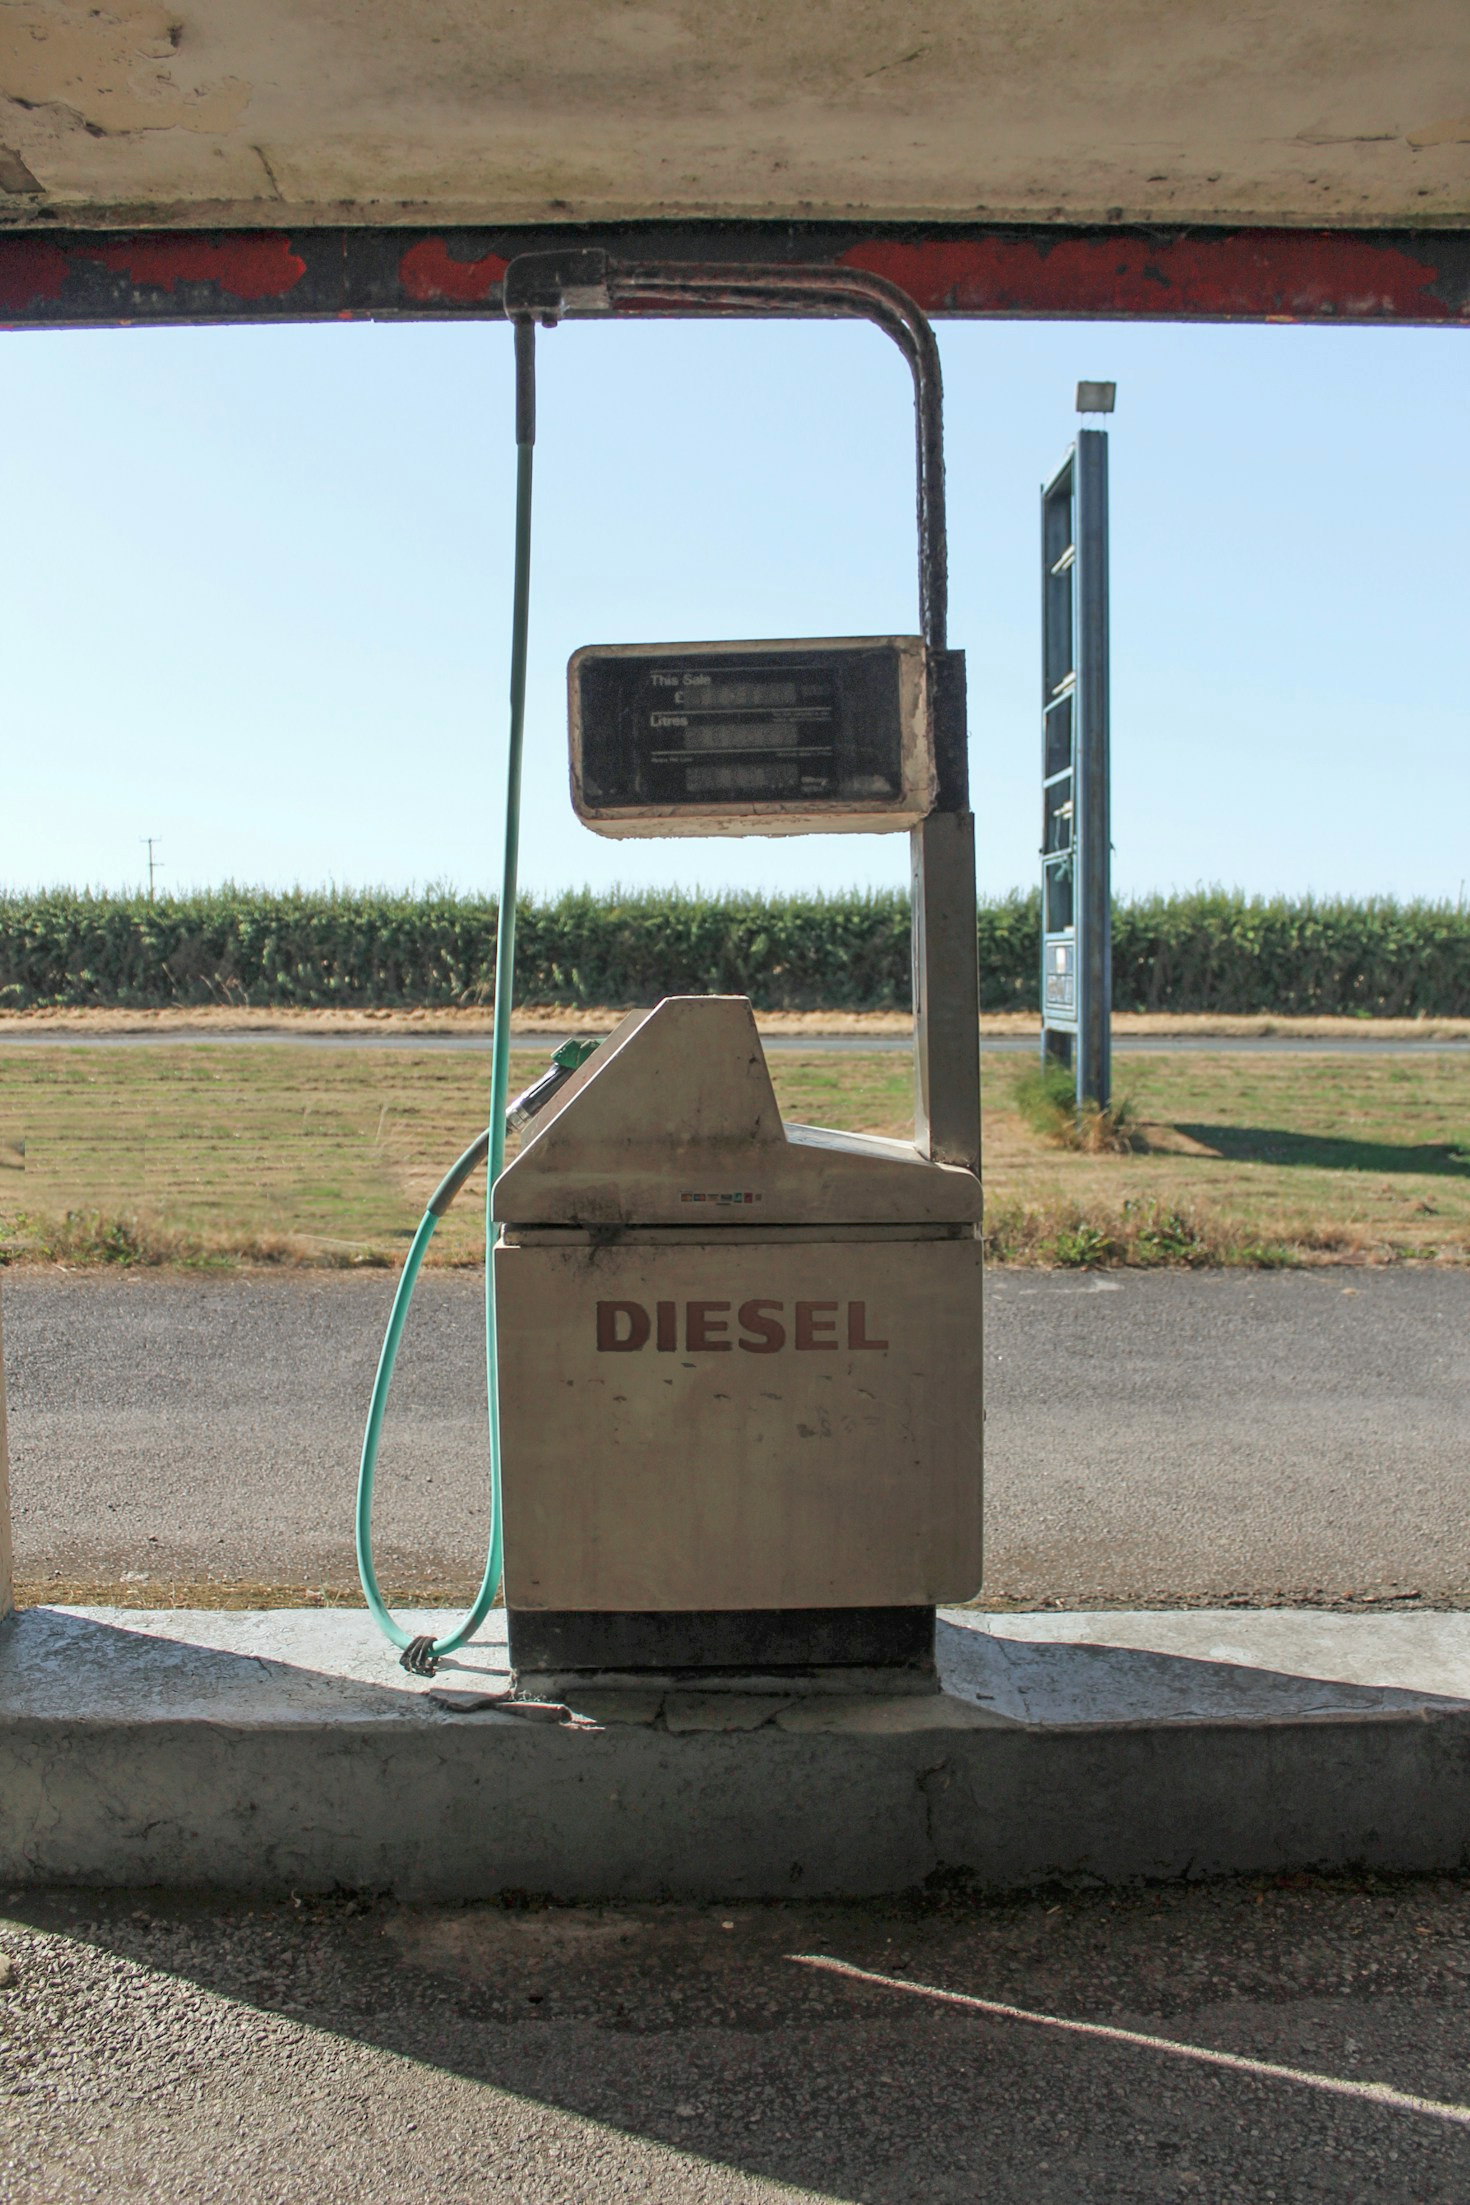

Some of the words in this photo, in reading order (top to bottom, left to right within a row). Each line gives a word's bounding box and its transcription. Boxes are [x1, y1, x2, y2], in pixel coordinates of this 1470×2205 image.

[651, 674, 679, 686] This
[682, 673, 712, 686] Sale
[650, 713, 688, 727] Litres
[596, 1299, 889, 1354] DIESEL
